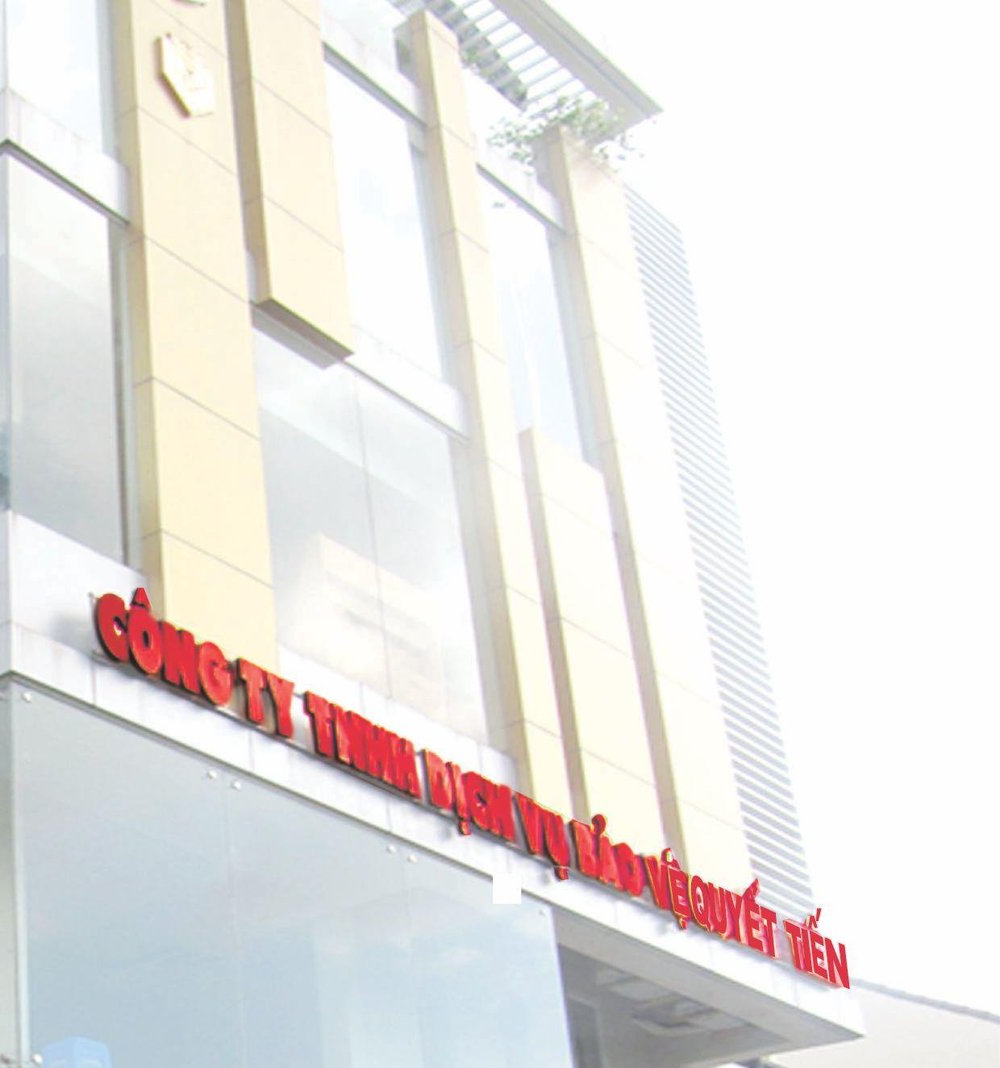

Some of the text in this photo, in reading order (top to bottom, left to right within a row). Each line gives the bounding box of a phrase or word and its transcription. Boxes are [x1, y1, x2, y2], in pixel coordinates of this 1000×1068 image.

[95, 587, 850, 989] CÔNG TY TNHH DỊCH VỤ BẢO VỆ QUYẾT TIẾN
